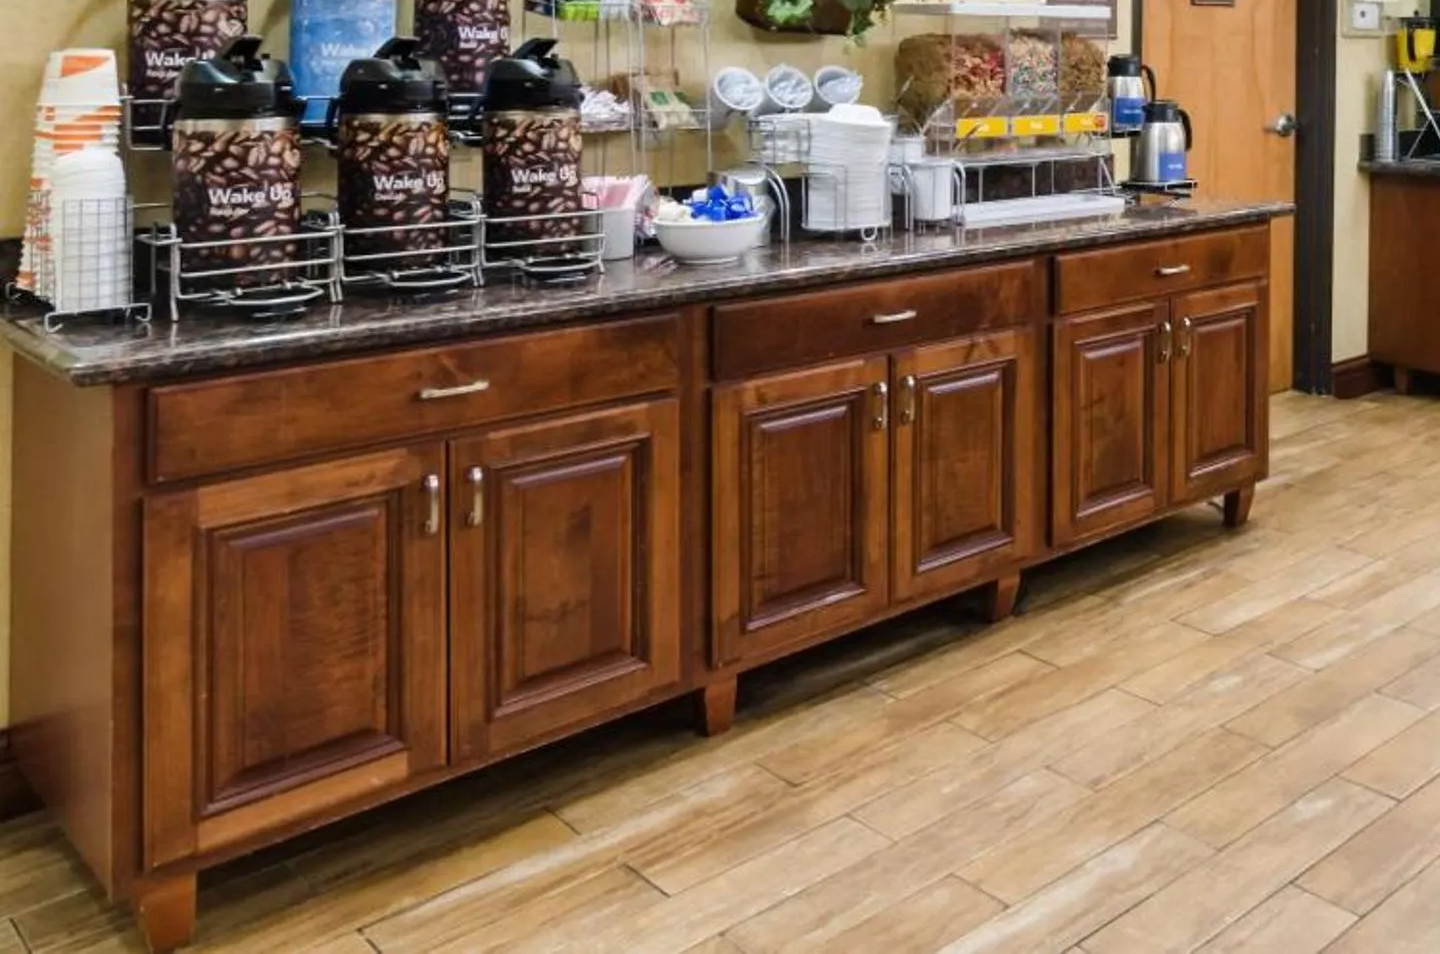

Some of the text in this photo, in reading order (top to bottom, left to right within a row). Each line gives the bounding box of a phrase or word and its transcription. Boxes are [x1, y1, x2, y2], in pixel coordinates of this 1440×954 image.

[458, 25, 498, 40] Wake
[372, 174, 424, 191] Wake
[510, 167, 557, 183] Wake
[208, 184, 294, 205] Wake Up
